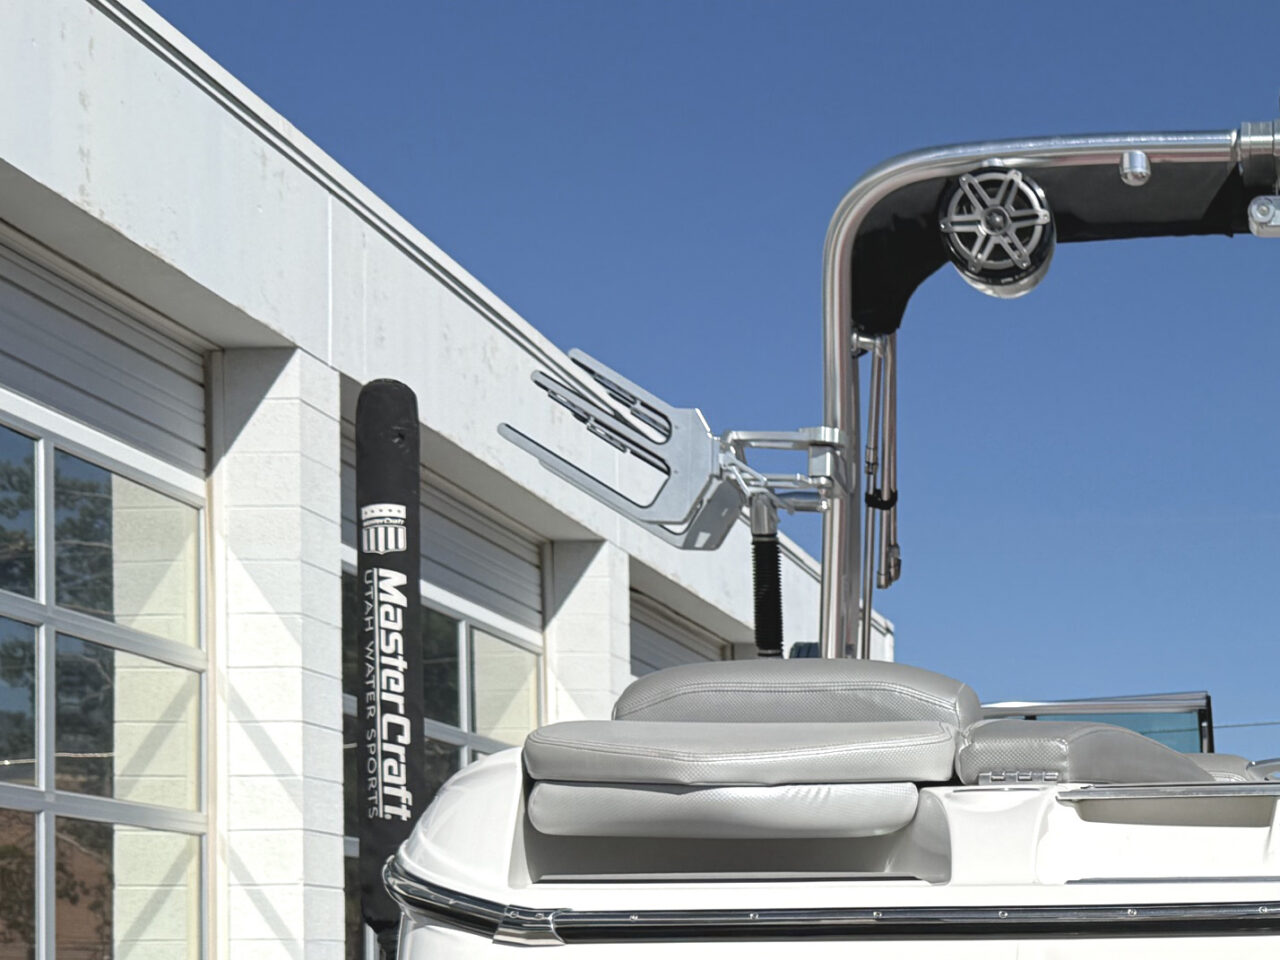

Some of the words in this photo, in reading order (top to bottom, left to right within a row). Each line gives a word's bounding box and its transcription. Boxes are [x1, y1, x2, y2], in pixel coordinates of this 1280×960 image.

[364, 569, 375, 632] UTAH
[364, 641, 377, 719] WATER
[379, 568, 413, 821] MasterCraft
[366, 728, 379, 819] SPORTS
